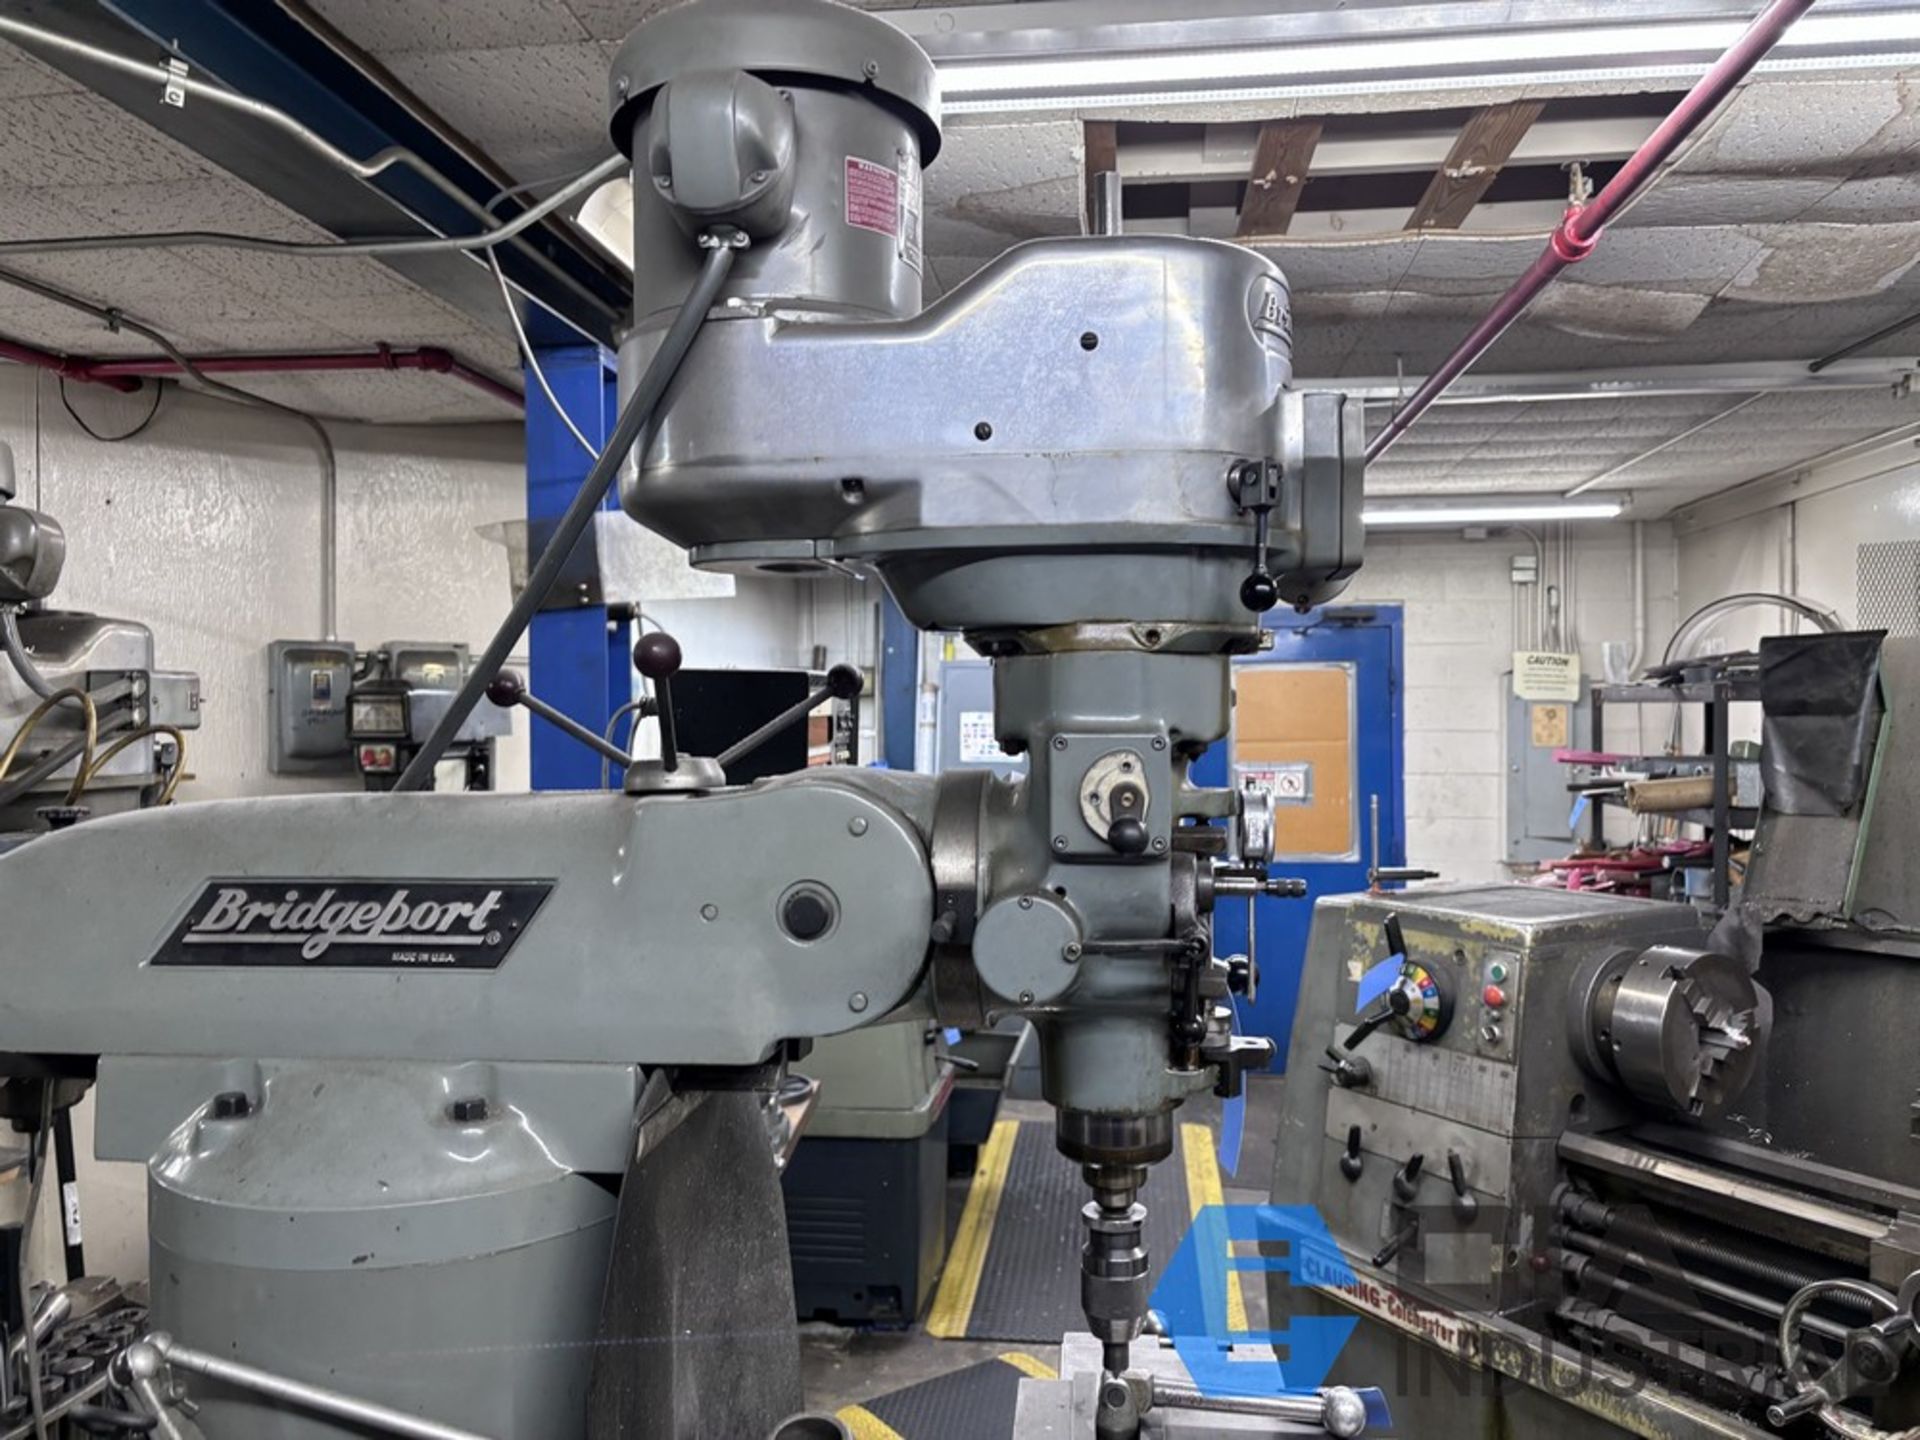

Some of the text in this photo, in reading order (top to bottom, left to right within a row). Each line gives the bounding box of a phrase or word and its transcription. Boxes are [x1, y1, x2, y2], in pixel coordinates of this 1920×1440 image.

[1526, 655, 1570, 668] CAUTION
[190, 887, 502, 960] Bridgeport
[392, 951, 416, 963] MADE
